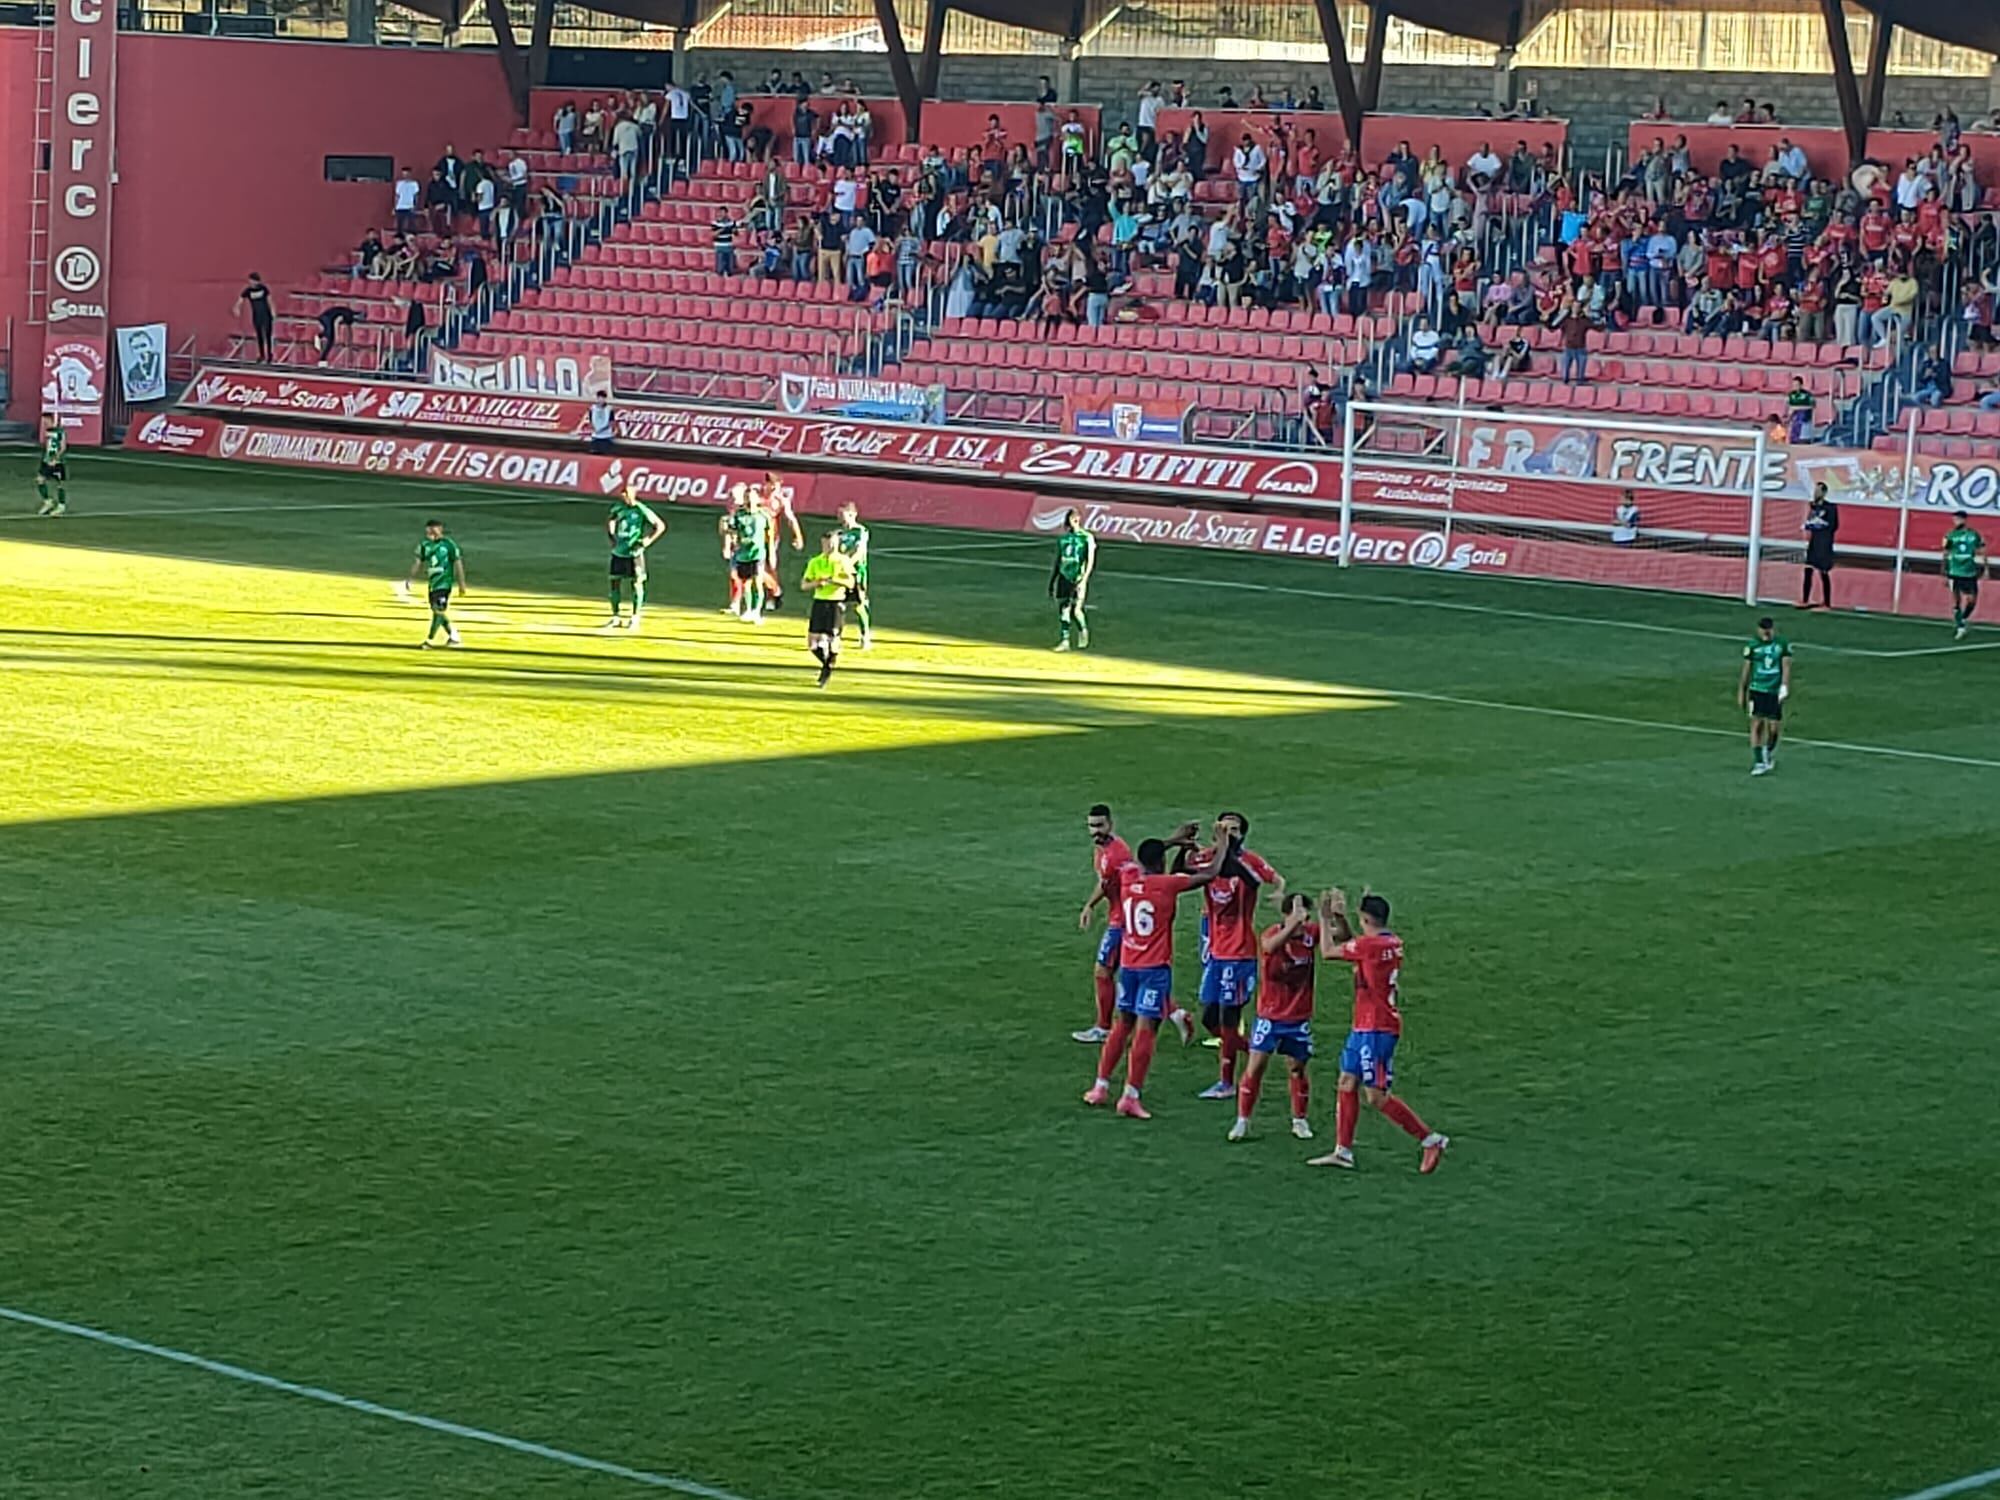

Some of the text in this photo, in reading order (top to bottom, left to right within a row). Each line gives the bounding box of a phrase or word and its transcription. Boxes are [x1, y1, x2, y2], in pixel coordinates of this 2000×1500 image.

[227, 385, 340, 410] Caja Soria
[425, 394, 561, 421] SAN MIGUEL
[618, 421, 746, 448] NUMANCIA
[899, 432, 940, 458] LA
[945, 436, 1009, 463] ISLA
[1609, 438, 1788, 491] FRENTE
[627, 466, 709, 502] Grupo
[1927, 463, 2000, 509] RO
[1084, 504, 1258, 546] Torrezno de Soria
[1443, 543, 1508, 570] Soria
[1123, 897, 1155, 937] 16
